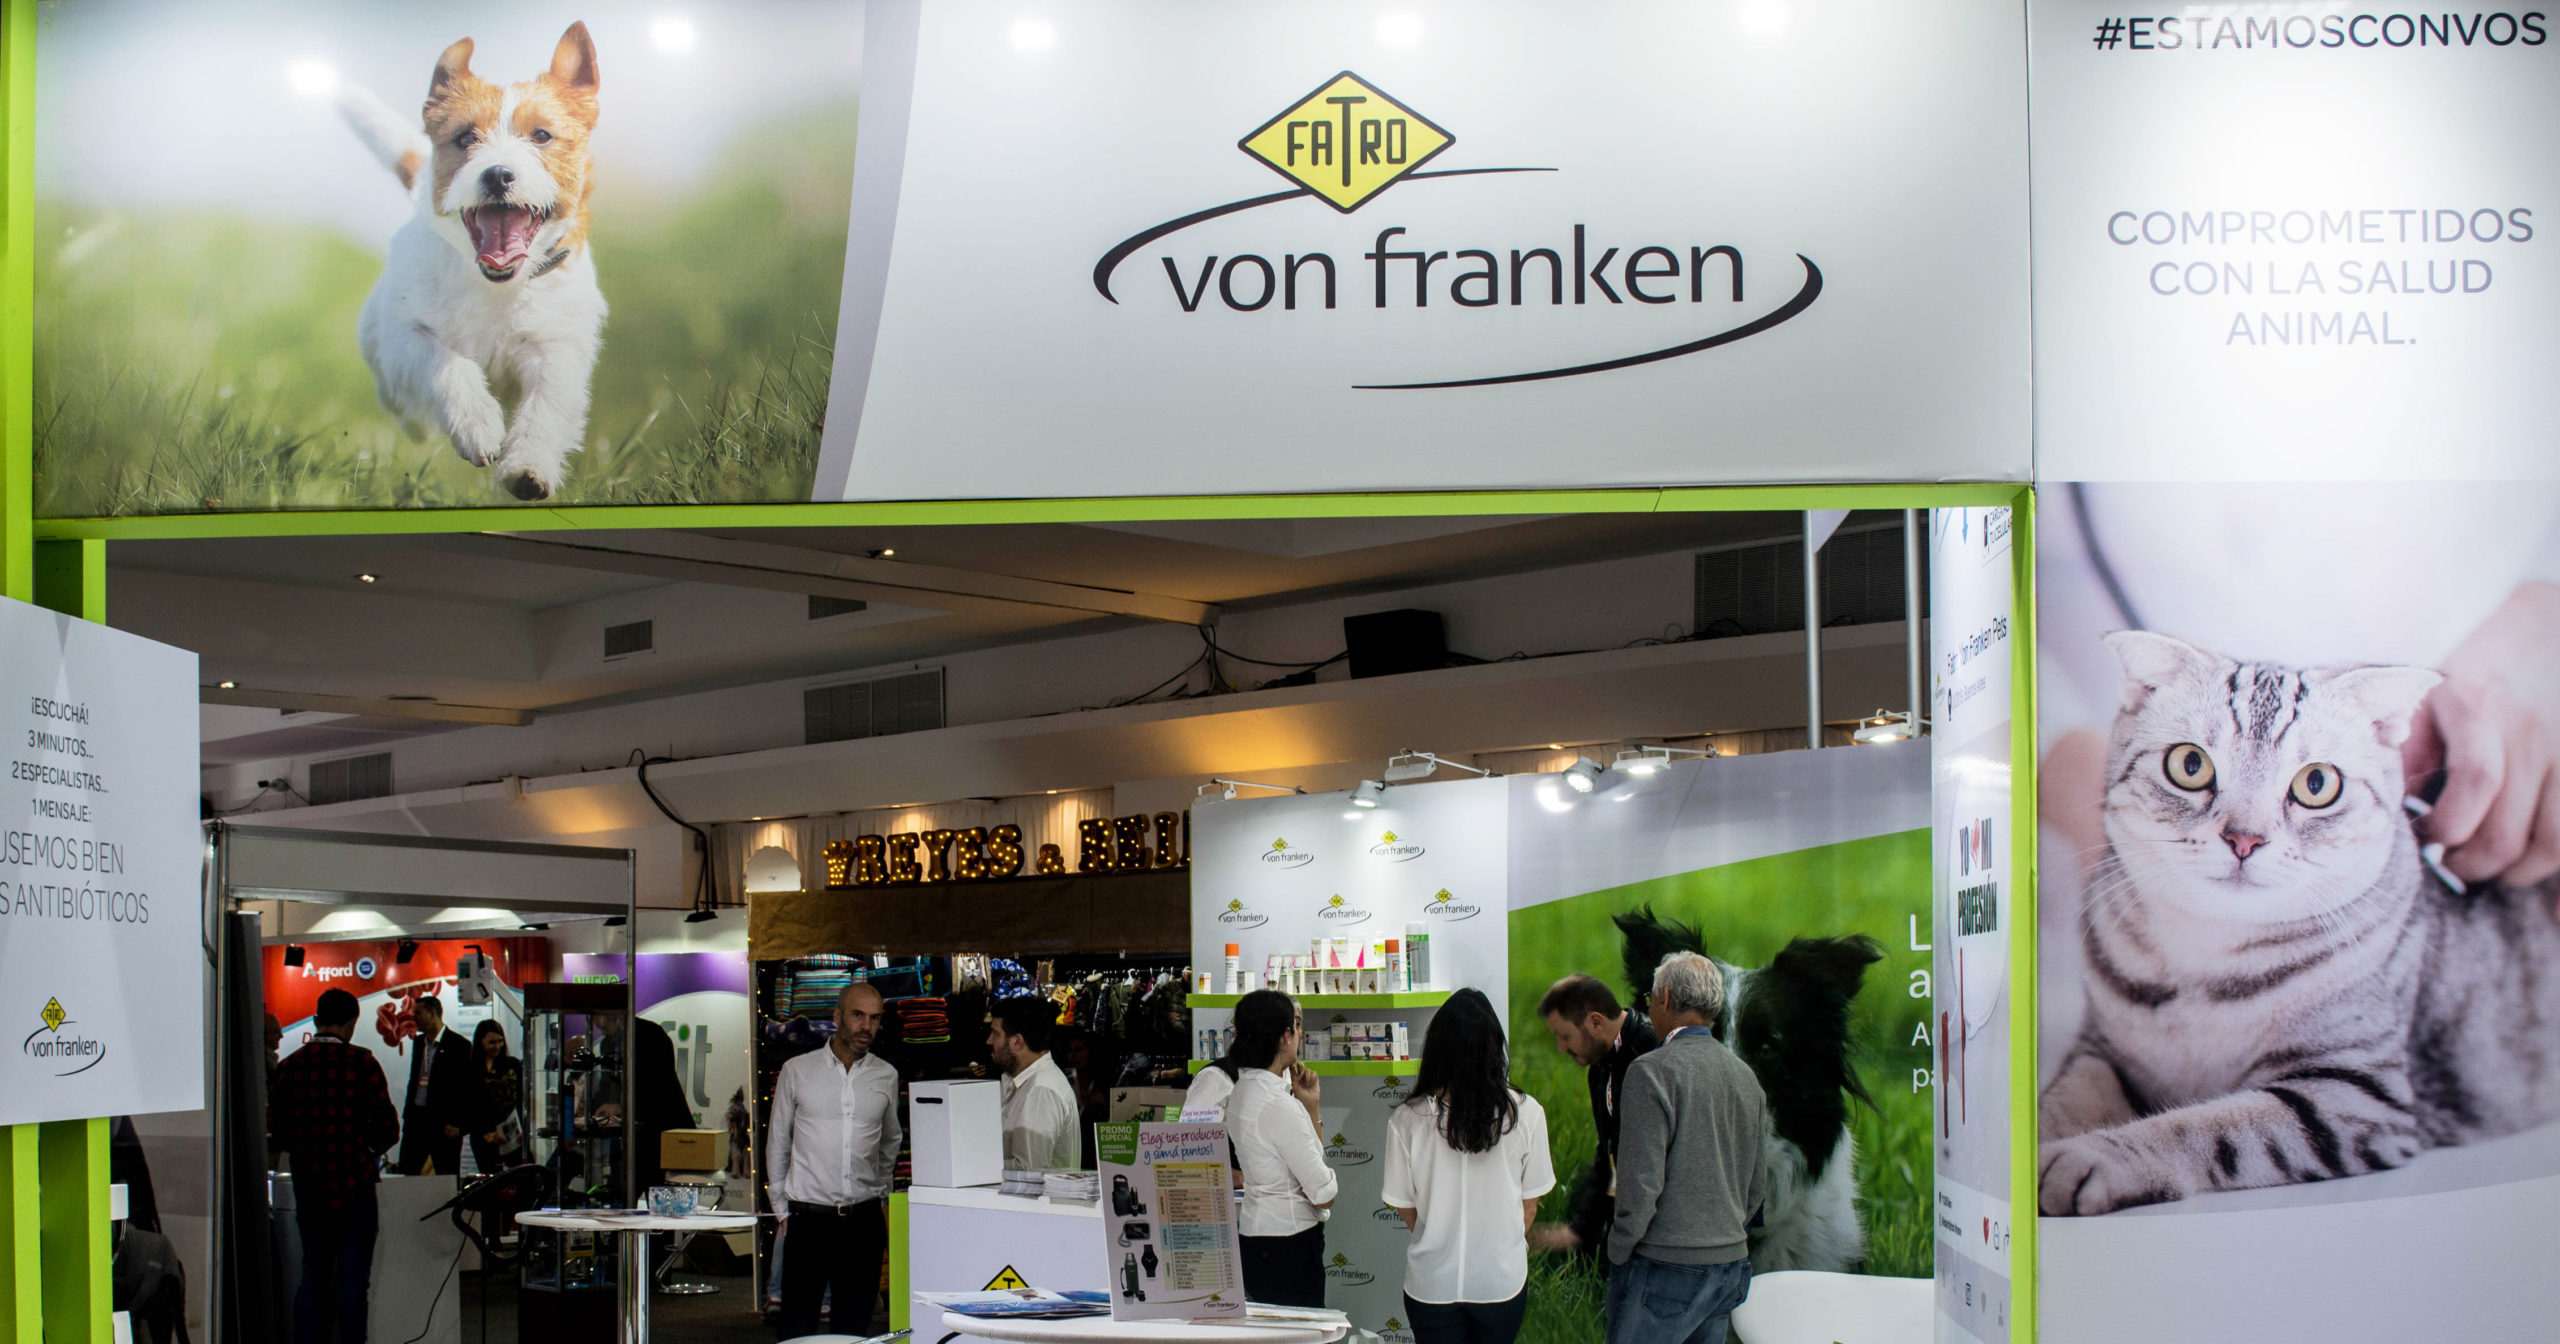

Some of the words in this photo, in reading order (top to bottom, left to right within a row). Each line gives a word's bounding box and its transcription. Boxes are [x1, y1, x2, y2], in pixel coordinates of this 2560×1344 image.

[2093, 11, 2547, 50] #ESTAMOSCONVOS
[1286, 95, 1408, 188] FATRO
[2107, 207, 2534, 246] COMPROMETIDOS
[1161, 253, 1337, 313] von
[1365, 223, 1744, 309] franken
[2149, 260, 2253, 296] CON
[2269, 260, 2326, 296] LA
[2337, 259, 2493, 295] SALUD
[2225, 311, 2417, 346] ANIMAL.
[1992, 614, 2007, 644] Pets
[31, 696, 89, 725] ¡ESCUCHÁ!
[28, 729, 36, 748] 3
[37, 731, 94, 759] MINUTOS...
[12, 760, 19, 779] 2
[21, 762, 109, 793] ESPECIALISTAS...
[32, 798, 37, 816] 1
[39, 799, 92, 823] MENSAJE:
[82, 840, 124, 875] BIEN
[856, 824, 1024, 886] REYES
[1037, 843, 1066, 875] &
[1267, 854, 1280, 863] von
[1281, 851, 1309, 862] franken
[15, 880, 149, 924] ANTIBIÓTICOS
[1323, 911, 1337, 919] von
[1338, 909, 1366, 918] franken
[1430, 906, 1443, 914] von
[1445, 904, 1475, 914] franken
[1237, 913, 1263, 922] franken
[32, 1041, 54, 1057] von
[55, 1035, 98, 1057] franken
[1377, 1091, 1391, 1099] von
[1100, 1125, 1132, 1134] PROMO
[1165, 1131, 1179, 1144] tus
[1181, 1128, 1225, 1147] productos
[1144, 1150, 1151, 1165] y
[1153, 1145, 1180, 1160] sumá
[1181, 1143, 1214, 1162] puntos!
[1325, 1150, 1339, 1158] von
[1340, 1148, 1368, 1159] franken
[1378, 1212, 1392, 1221] von
[1326, 1269, 1340, 1277] von
[1341, 1268, 1370, 1280] franken
